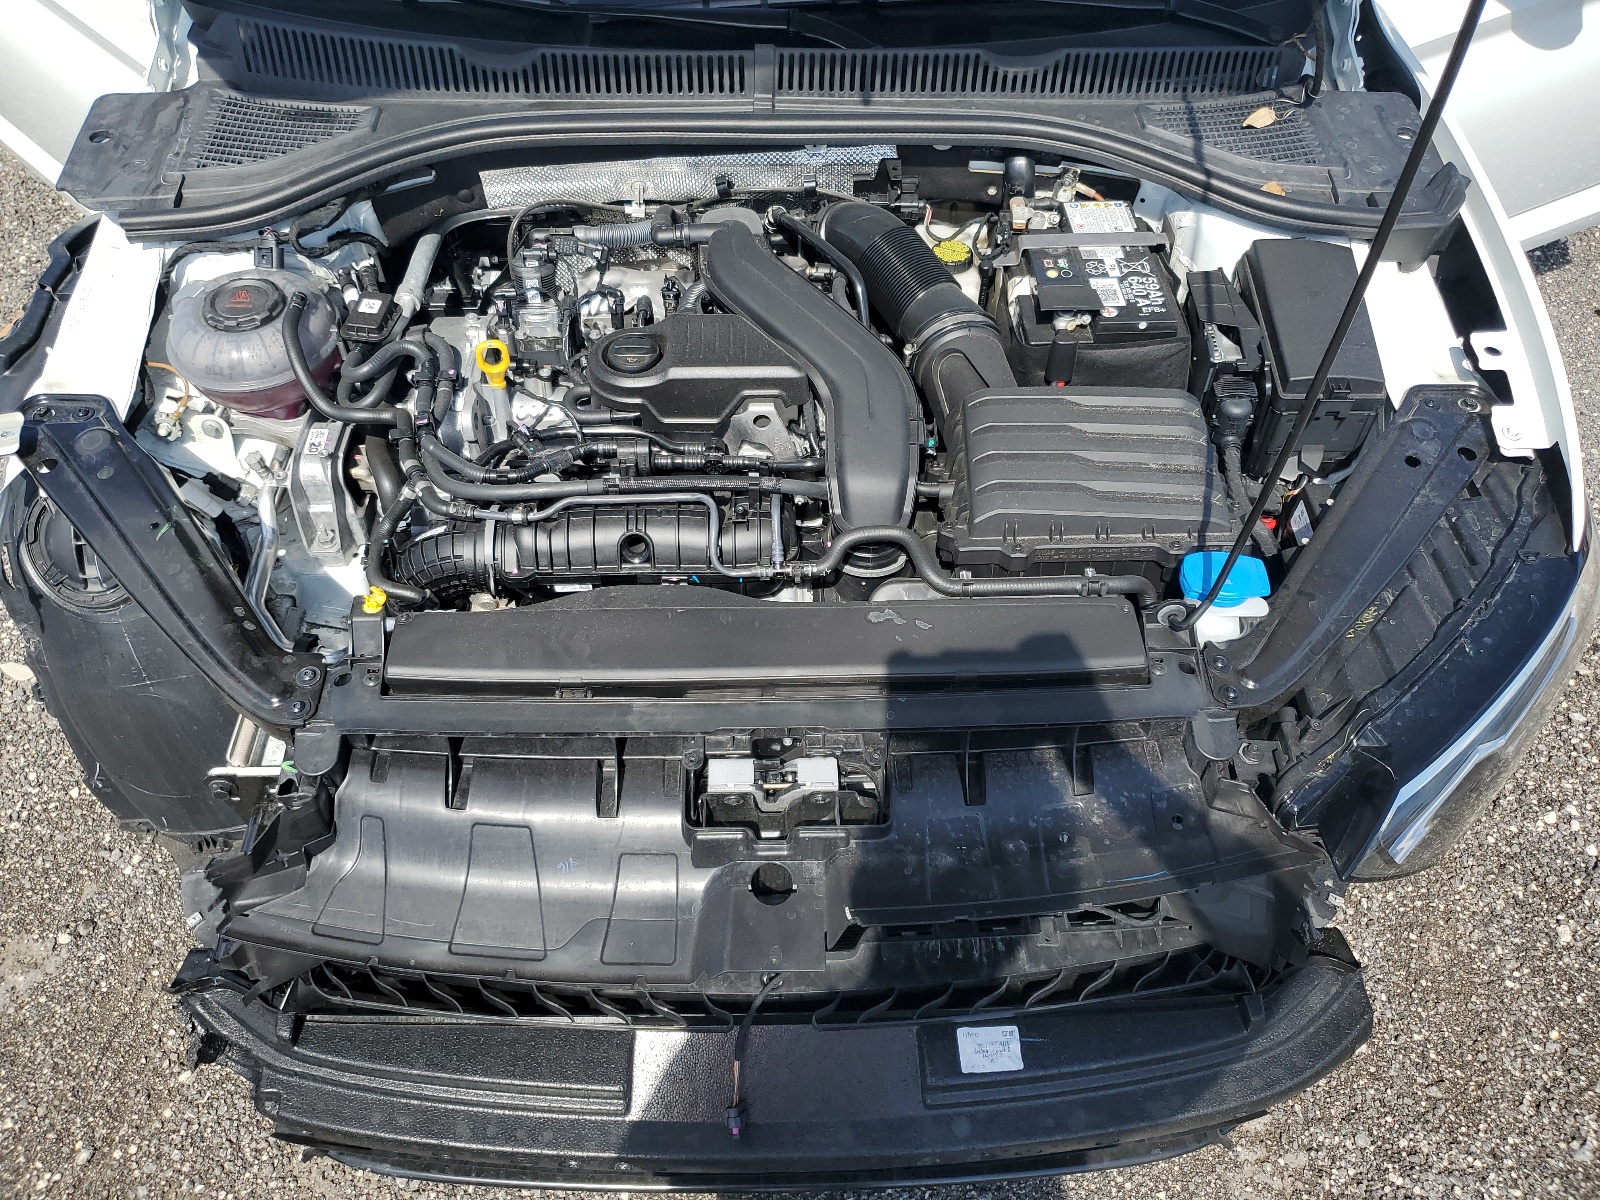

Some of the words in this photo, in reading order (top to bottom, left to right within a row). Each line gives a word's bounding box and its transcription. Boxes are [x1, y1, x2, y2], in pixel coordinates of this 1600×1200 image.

[1127, 276, 1147, 296] 640
[1142, 277, 1165, 305] 59Ah
[1134, 297, 1151, 307] A
